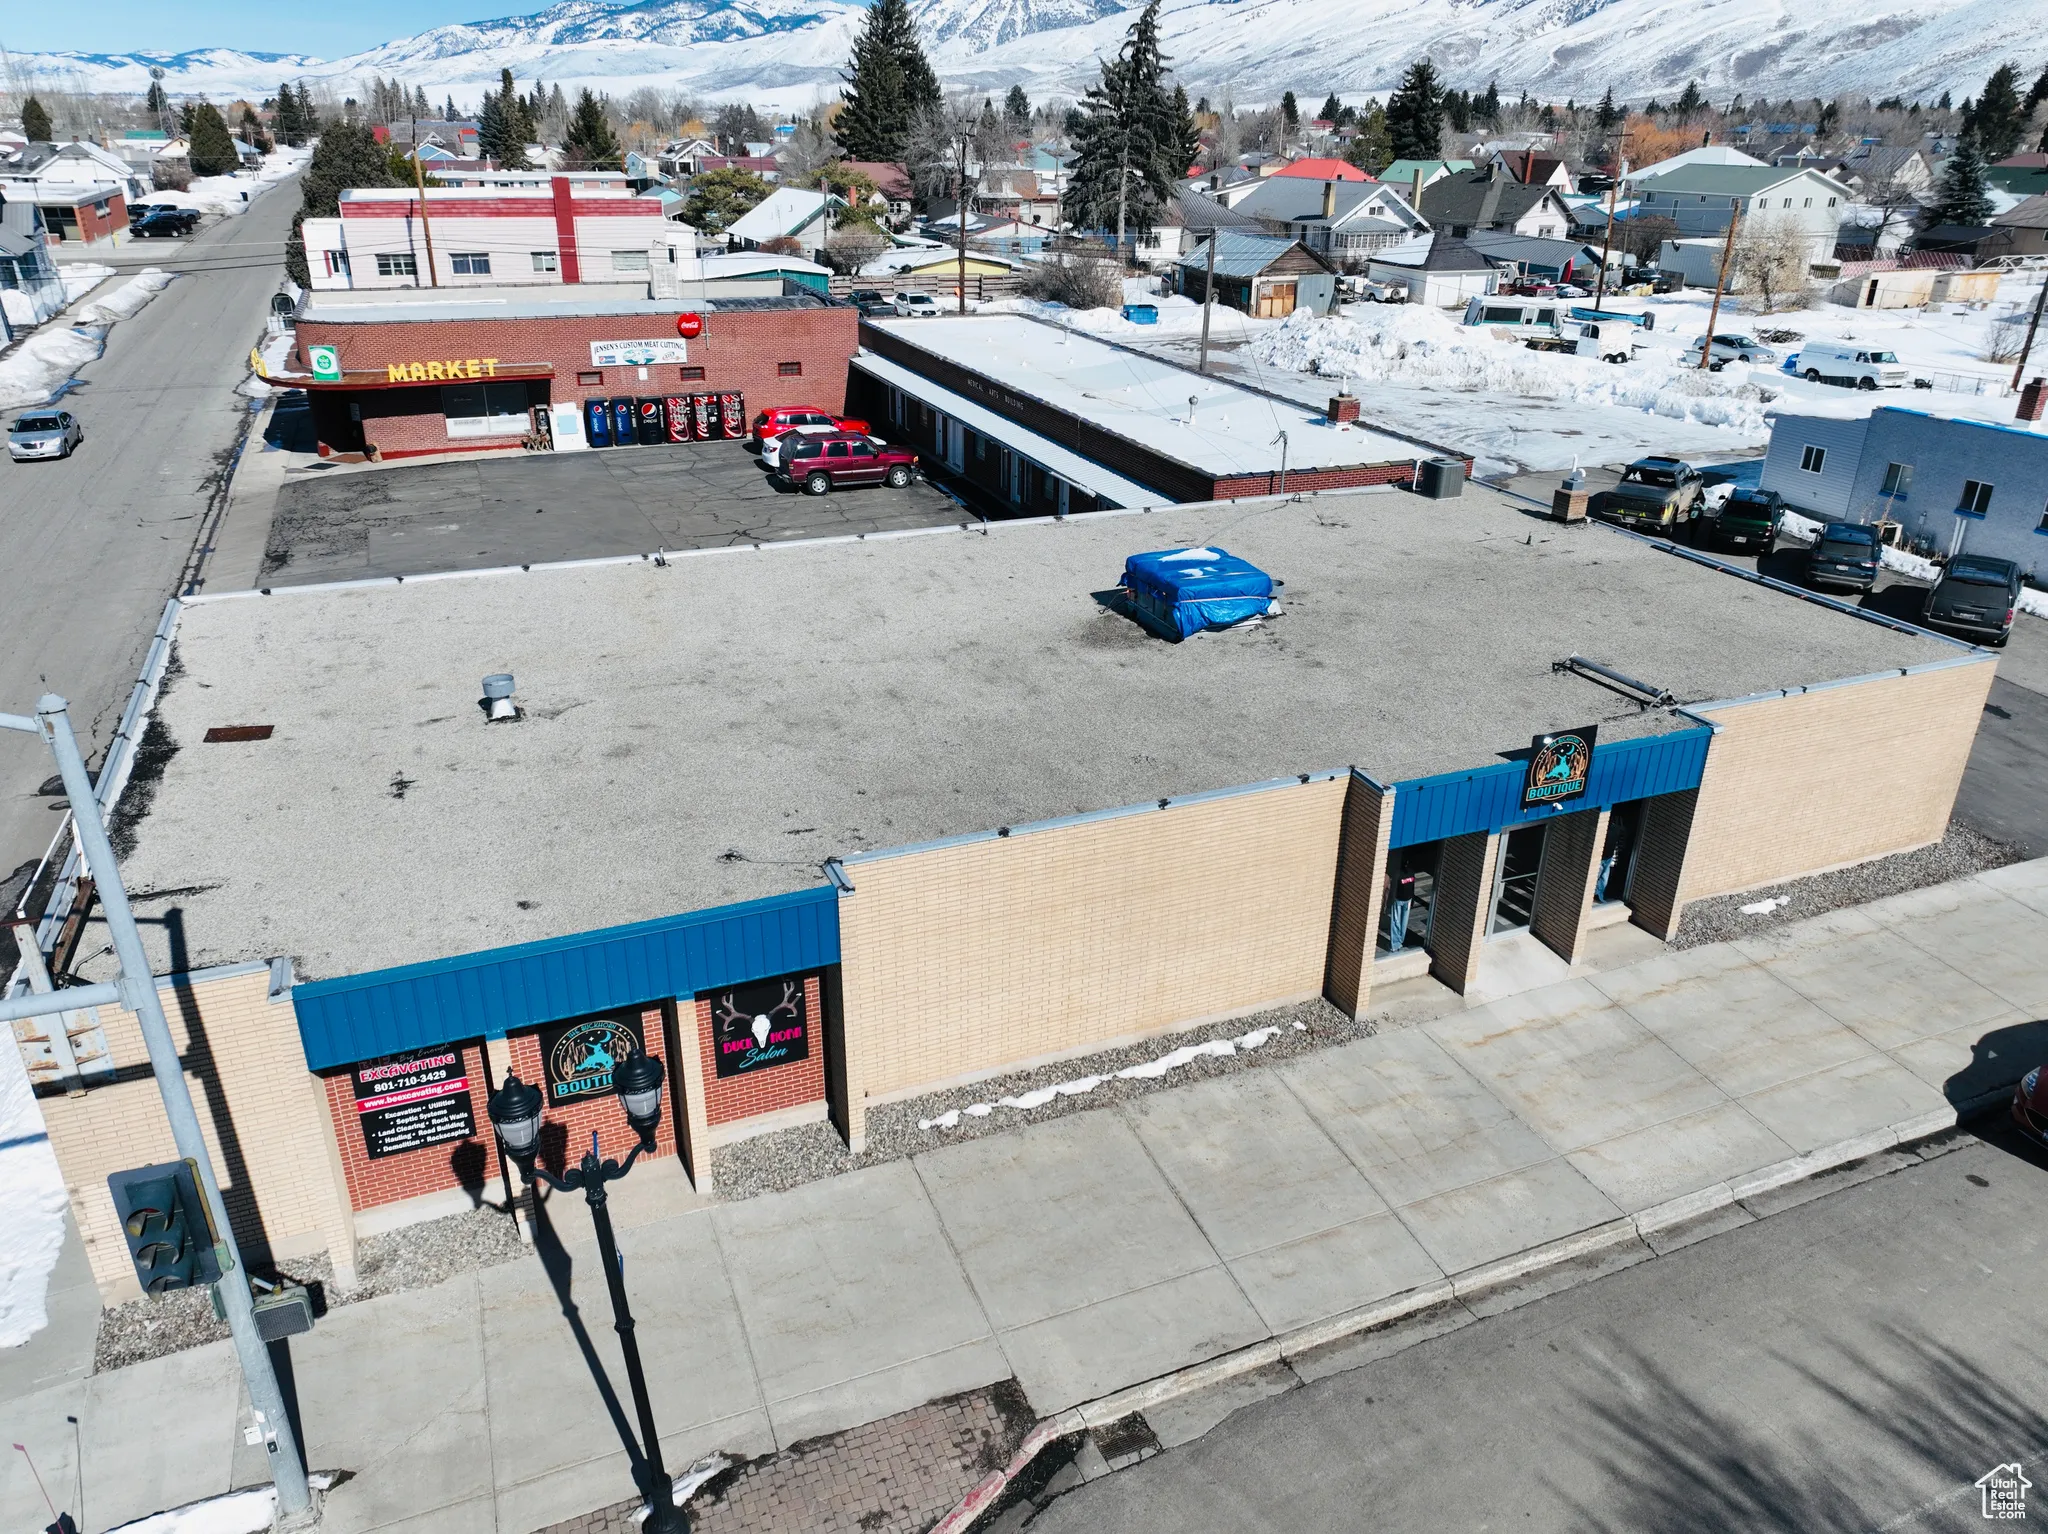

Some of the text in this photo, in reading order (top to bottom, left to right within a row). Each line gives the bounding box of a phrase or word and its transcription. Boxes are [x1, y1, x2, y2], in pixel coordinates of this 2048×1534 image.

[593, 340, 685, 355] JENSEN'S CUSTOM MEAT CUTTING
[387, 358, 499, 383] MARKET
[1528, 779, 1582, 799] BOUTIQUE
[567, 1021, 617, 1039] THE BUCKHORN
[723, 1026, 802, 1054] BUCK HORN
[417, 1043, 452, 1058] Enough
[739, 1045, 788, 1068] Salon
[359, 1053, 456, 1083] EXCAVATING
[374, 1069, 447, 1093] 801-710-3429
[364, 1081, 463, 1108] www.beexcavating.com
[384, 1099, 456, 1119] Excavation Utilities
[396, 1109, 448, 1125] Septic Systems
[378, 1112, 468, 1137] Land Clearing Rock Walls
[384, 1120, 466, 1144] Hauling Road Building
[383, 1128, 470, 1152] Demolition Rockscaping
